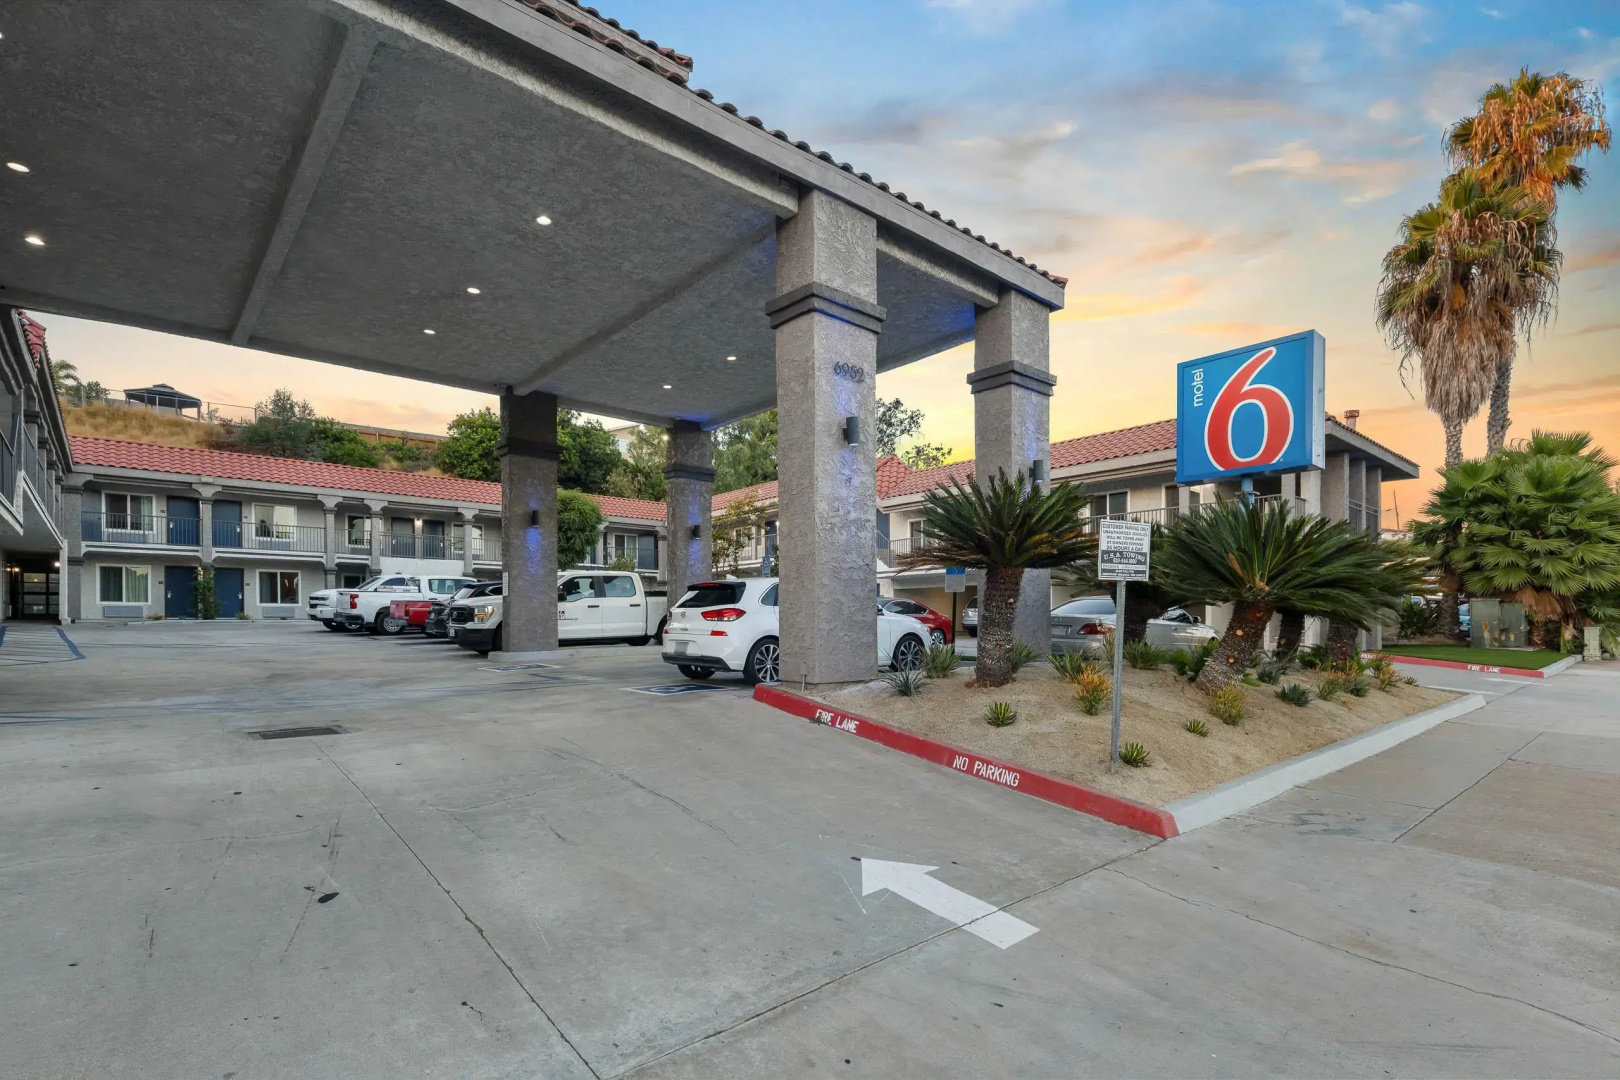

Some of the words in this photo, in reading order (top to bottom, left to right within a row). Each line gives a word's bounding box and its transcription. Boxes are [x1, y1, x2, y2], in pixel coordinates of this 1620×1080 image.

[1191, 368, 1204, 407] motel
[1204, 346, 1294, 471] 6
[1123, 552, 1145, 562] TOWING
[815, 709, 834, 726] FIRE
[836, 715, 859, 733] LANE
[952, 755, 969, 771] NO
[972, 761, 1020, 787] PARKING
